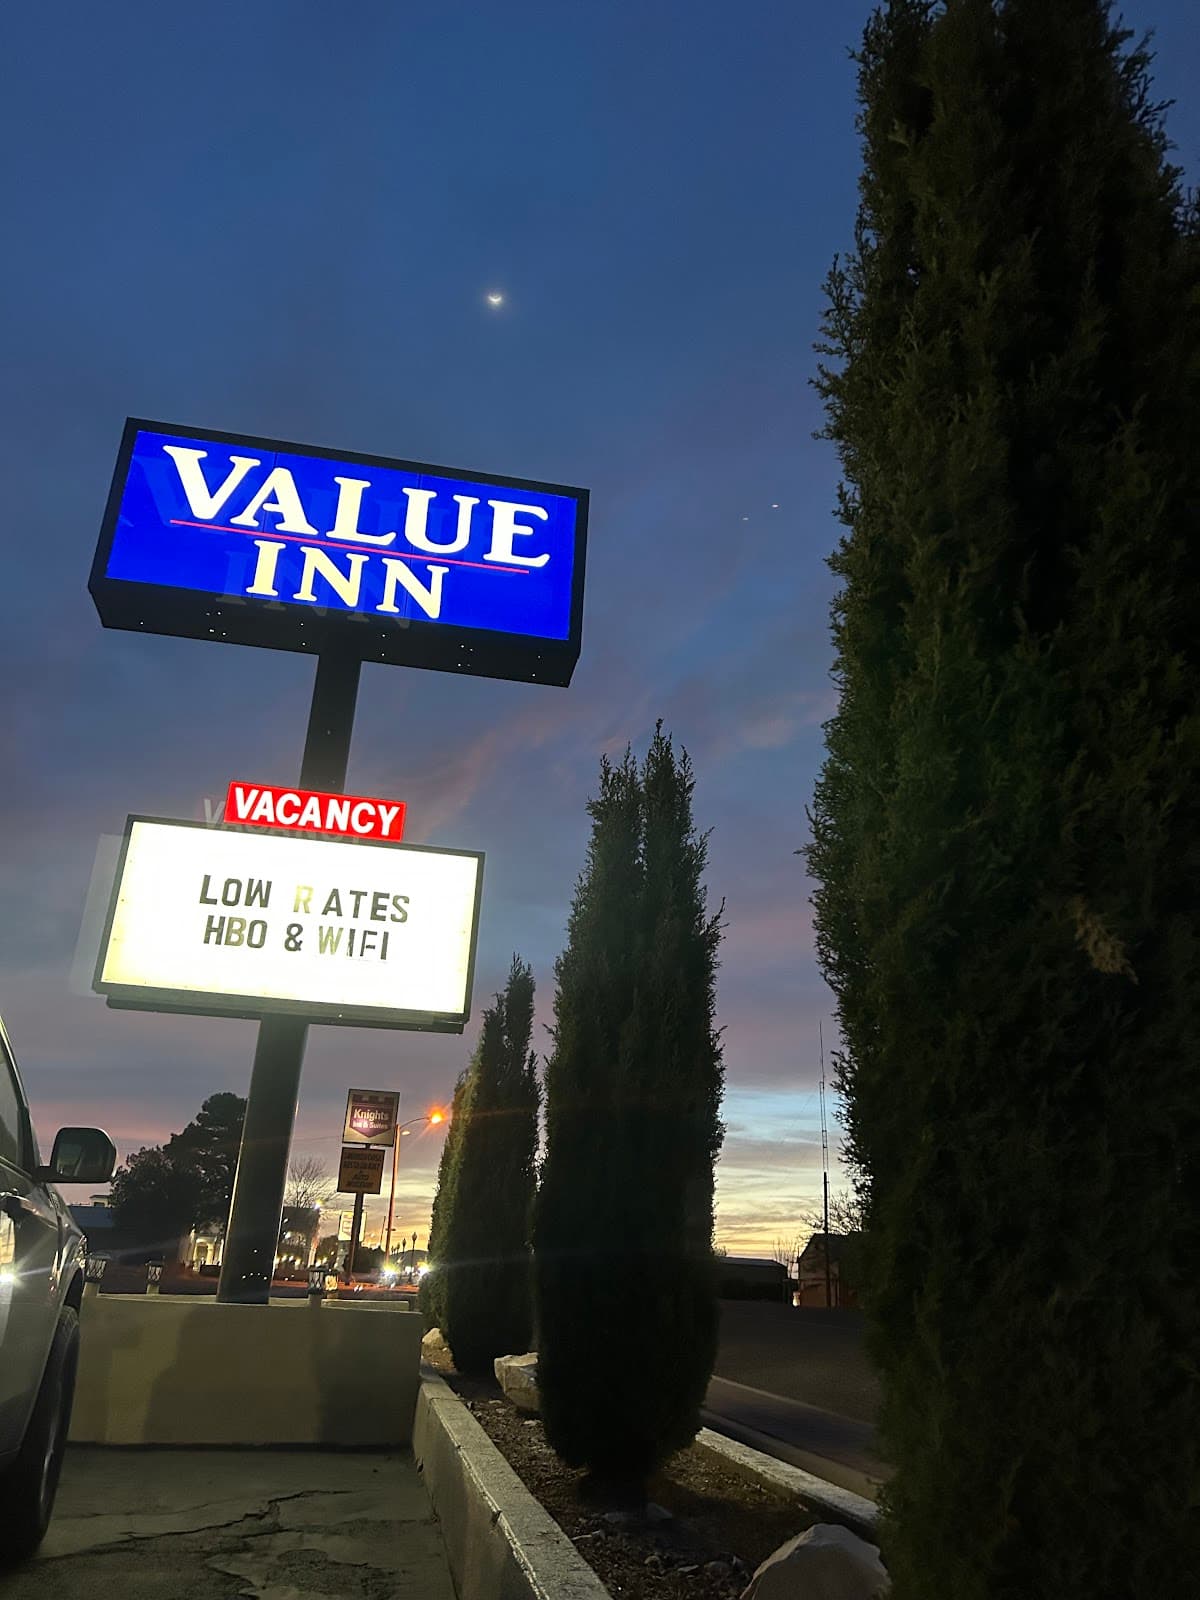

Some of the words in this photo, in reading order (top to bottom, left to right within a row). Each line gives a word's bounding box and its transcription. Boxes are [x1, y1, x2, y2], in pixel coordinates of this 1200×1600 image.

[163, 445, 550, 568] VALUE
[246, 540, 449, 619] INN
[233, 786, 401, 837] VACANCY
[199, 874, 272, 908] LOW
[203, 915, 268, 949] HBO
[284, 923, 304, 952] &
[317, 925, 390, 961] WIFI
[353, 1108, 388, 1121] Knights
